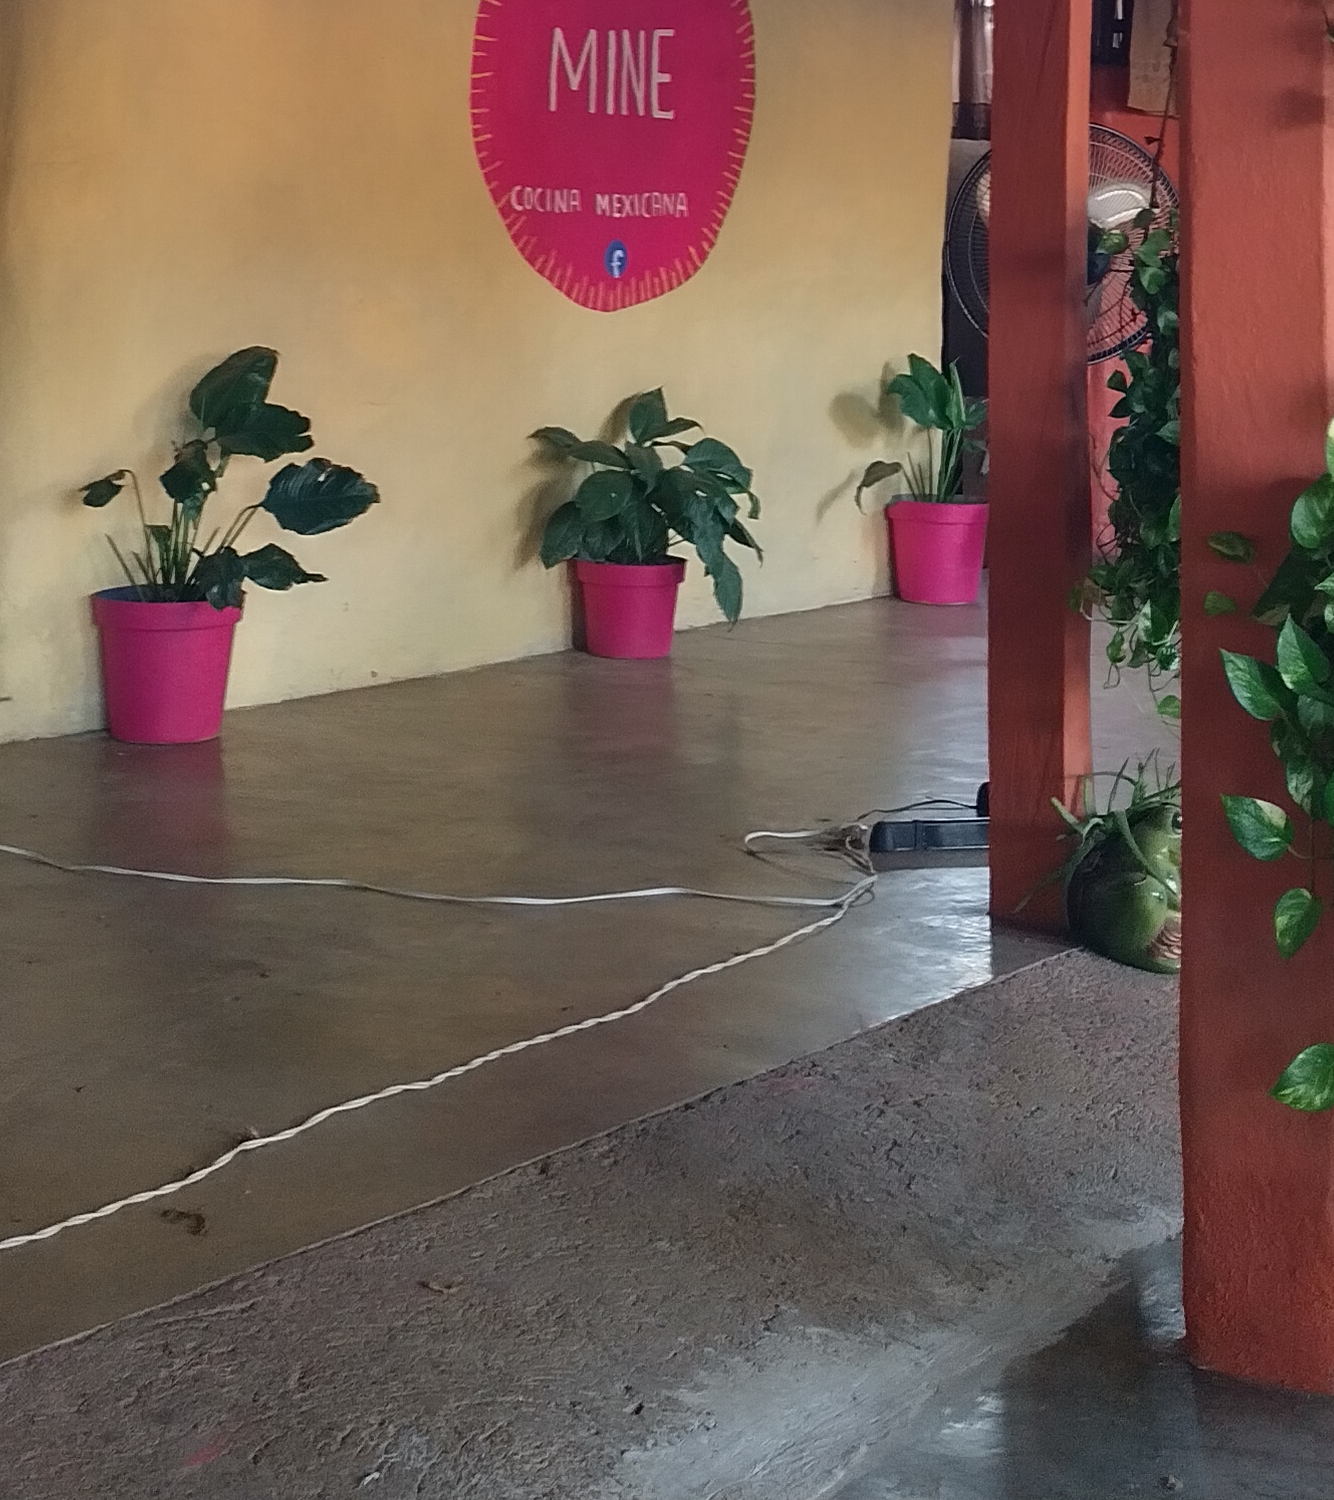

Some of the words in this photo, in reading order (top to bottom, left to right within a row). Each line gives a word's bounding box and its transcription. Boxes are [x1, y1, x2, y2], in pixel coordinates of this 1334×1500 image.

[547, 26, 676, 120] MINE
[510, 185, 582, 214] COCINA
[594, 191, 689, 219] MEXICANA
